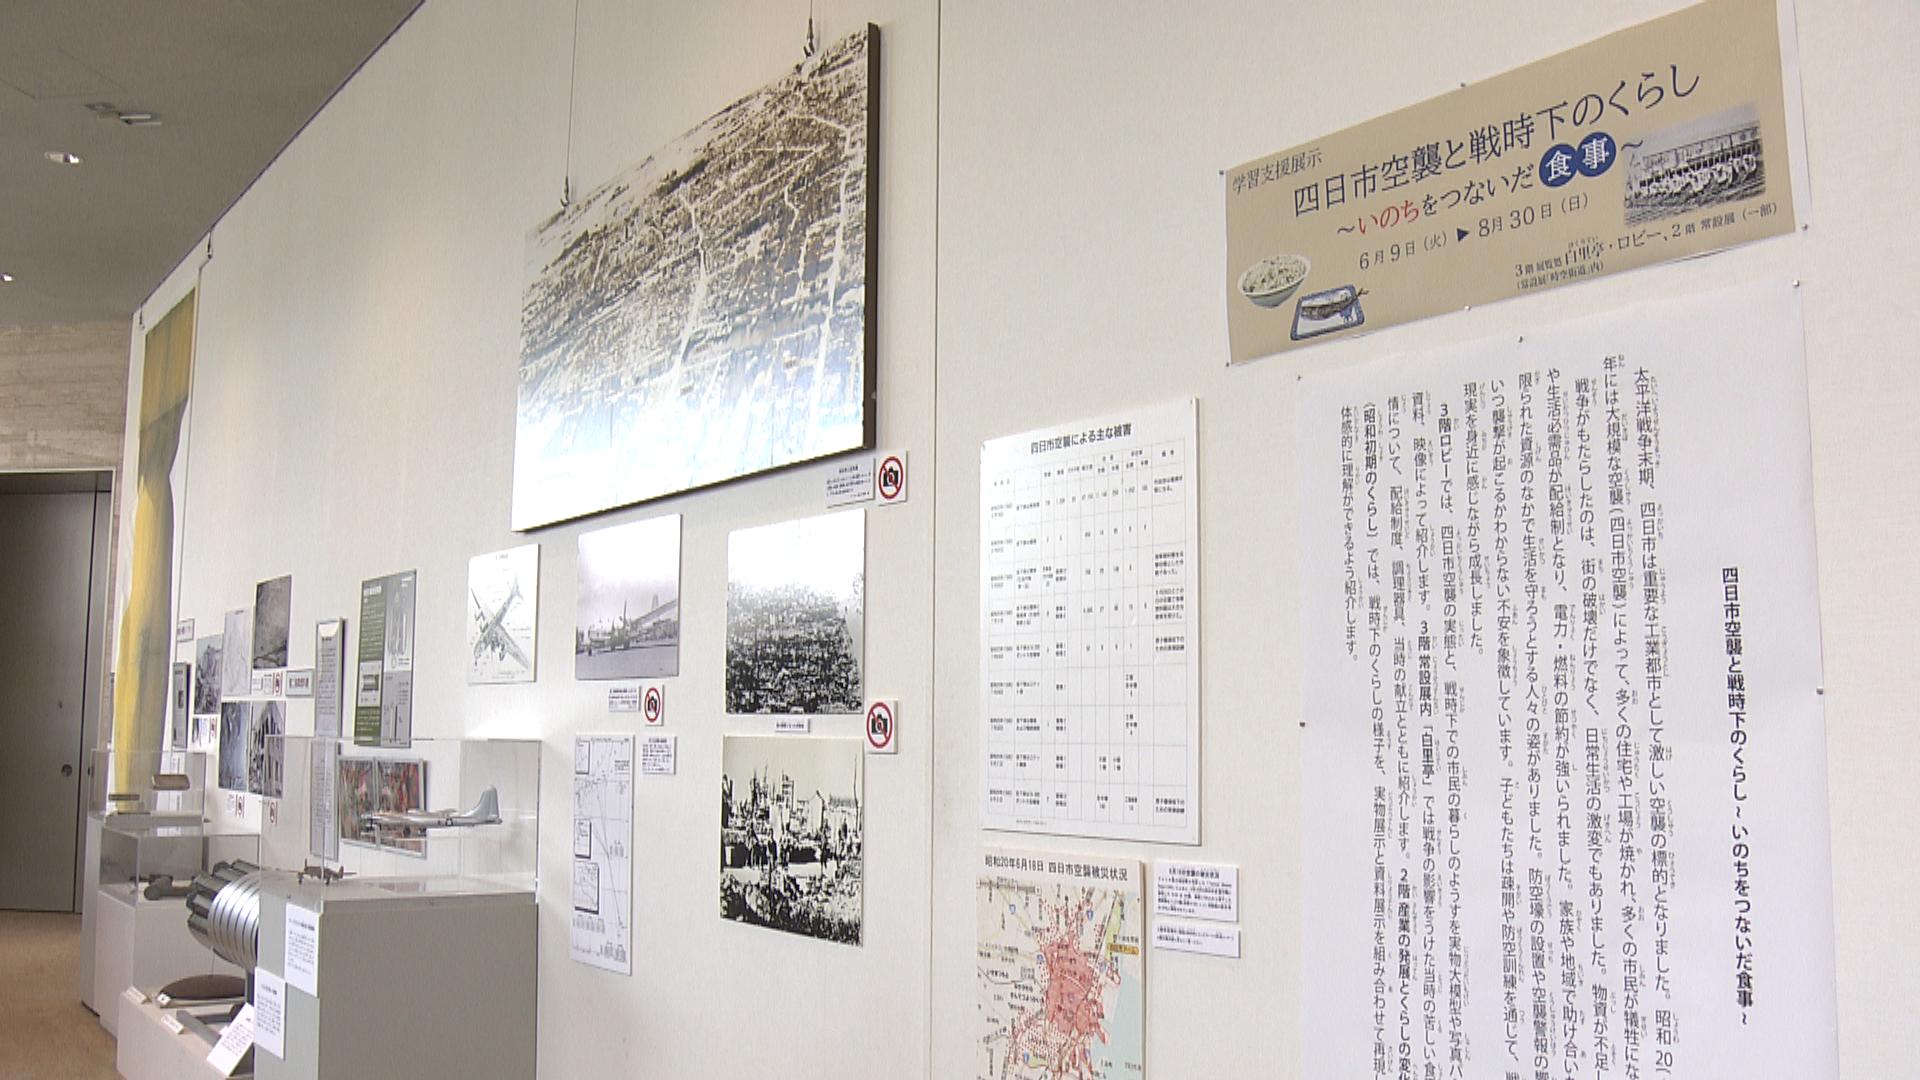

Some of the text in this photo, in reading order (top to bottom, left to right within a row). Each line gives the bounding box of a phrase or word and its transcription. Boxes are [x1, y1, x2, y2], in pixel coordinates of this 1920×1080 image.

[1231, 148, 1322, 195] 学習支援展示
[1293, 63, 1701, 218] 四日市空襲と戦時下のくらし
